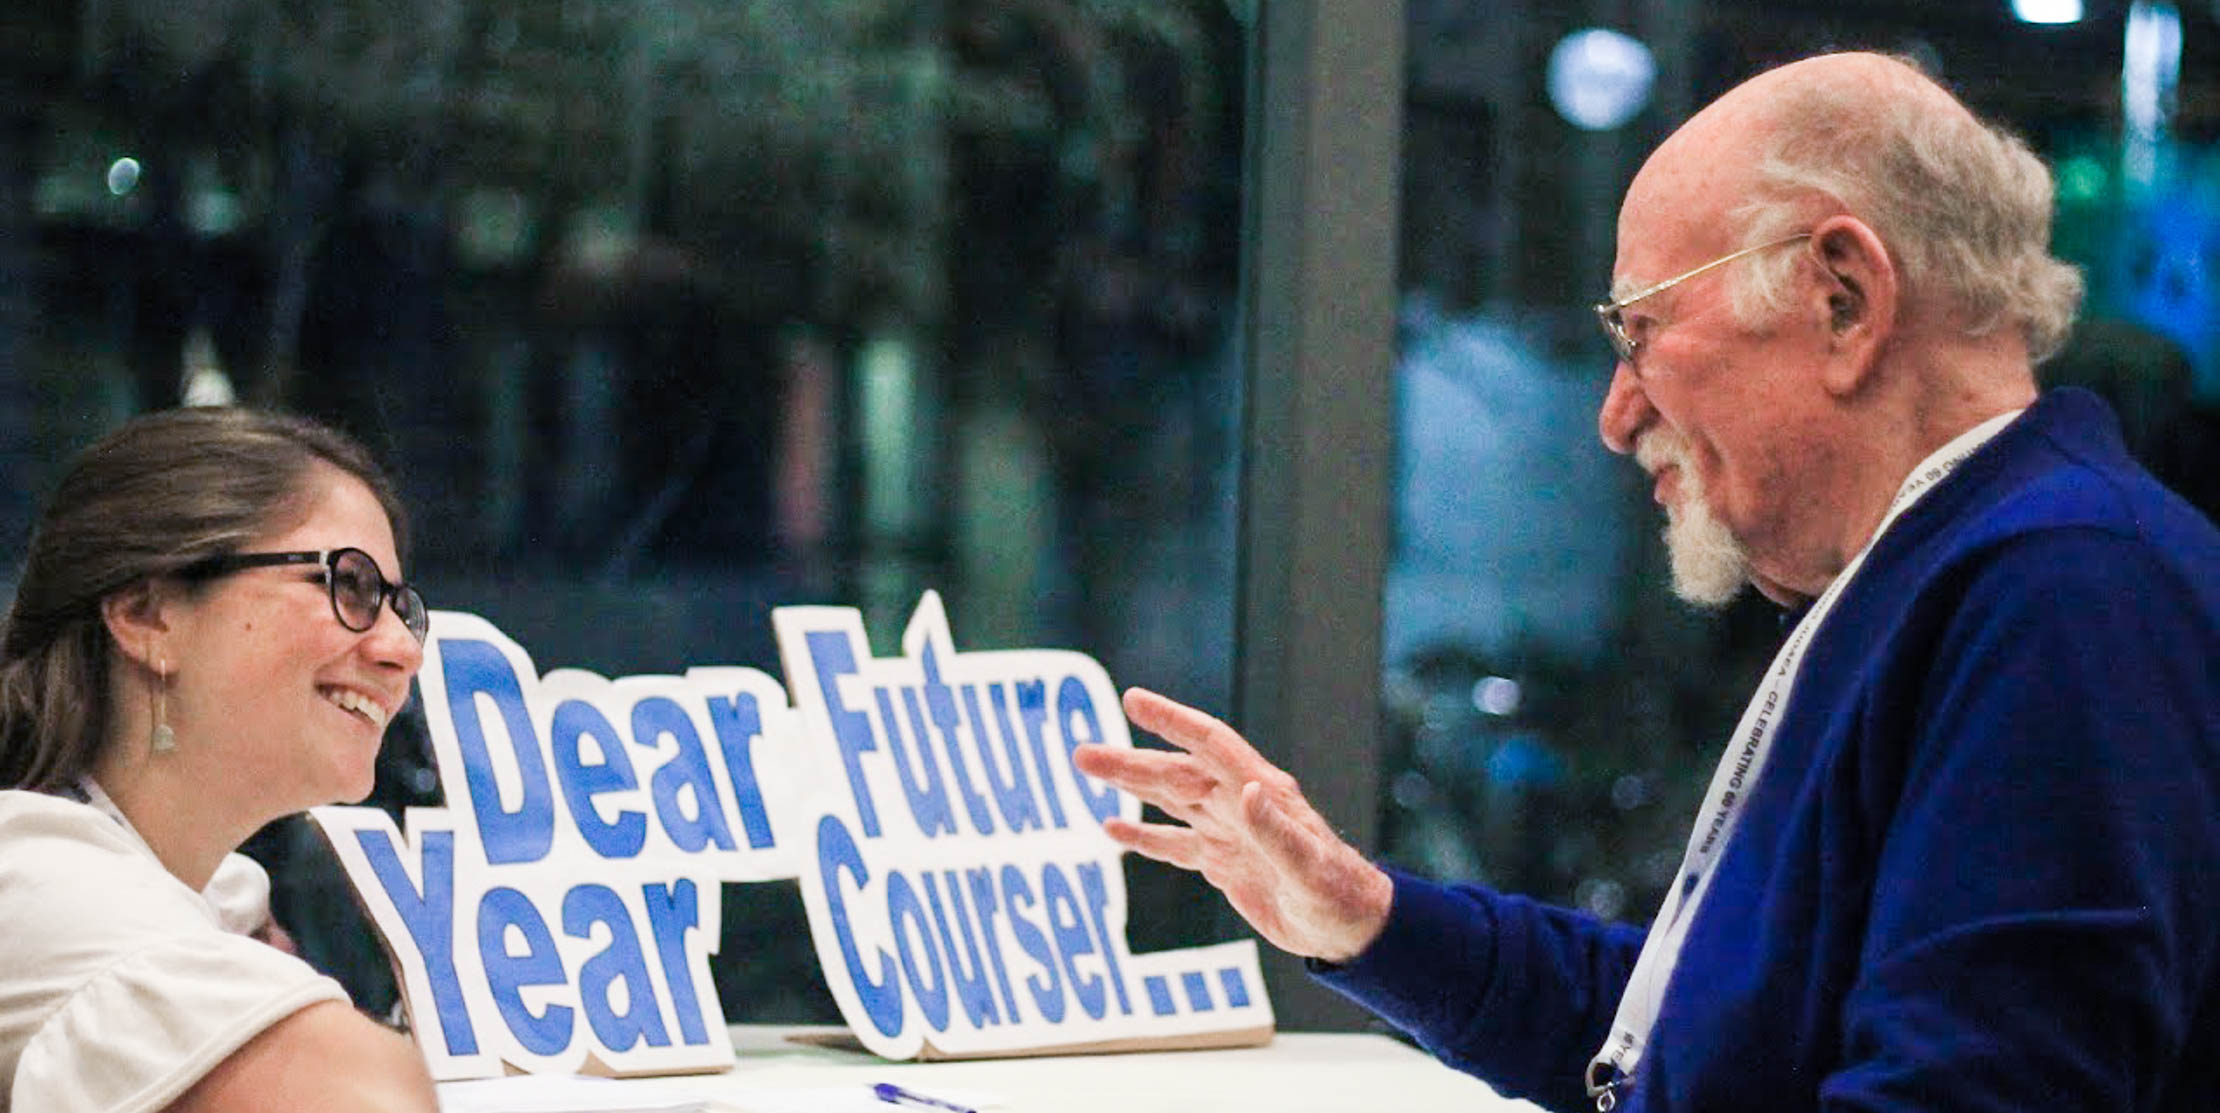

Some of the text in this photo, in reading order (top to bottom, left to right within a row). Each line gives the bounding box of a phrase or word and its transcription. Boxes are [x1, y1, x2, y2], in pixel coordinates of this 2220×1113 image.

[438, 631, 1121, 865] Dear Future
[1729, 690, 1779, 789] CELEBRATING
[1700, 809, 1729, 854] YEARS
[1722, 790, 1737, 807] 60
[354, 830, 710, 1056] Year
